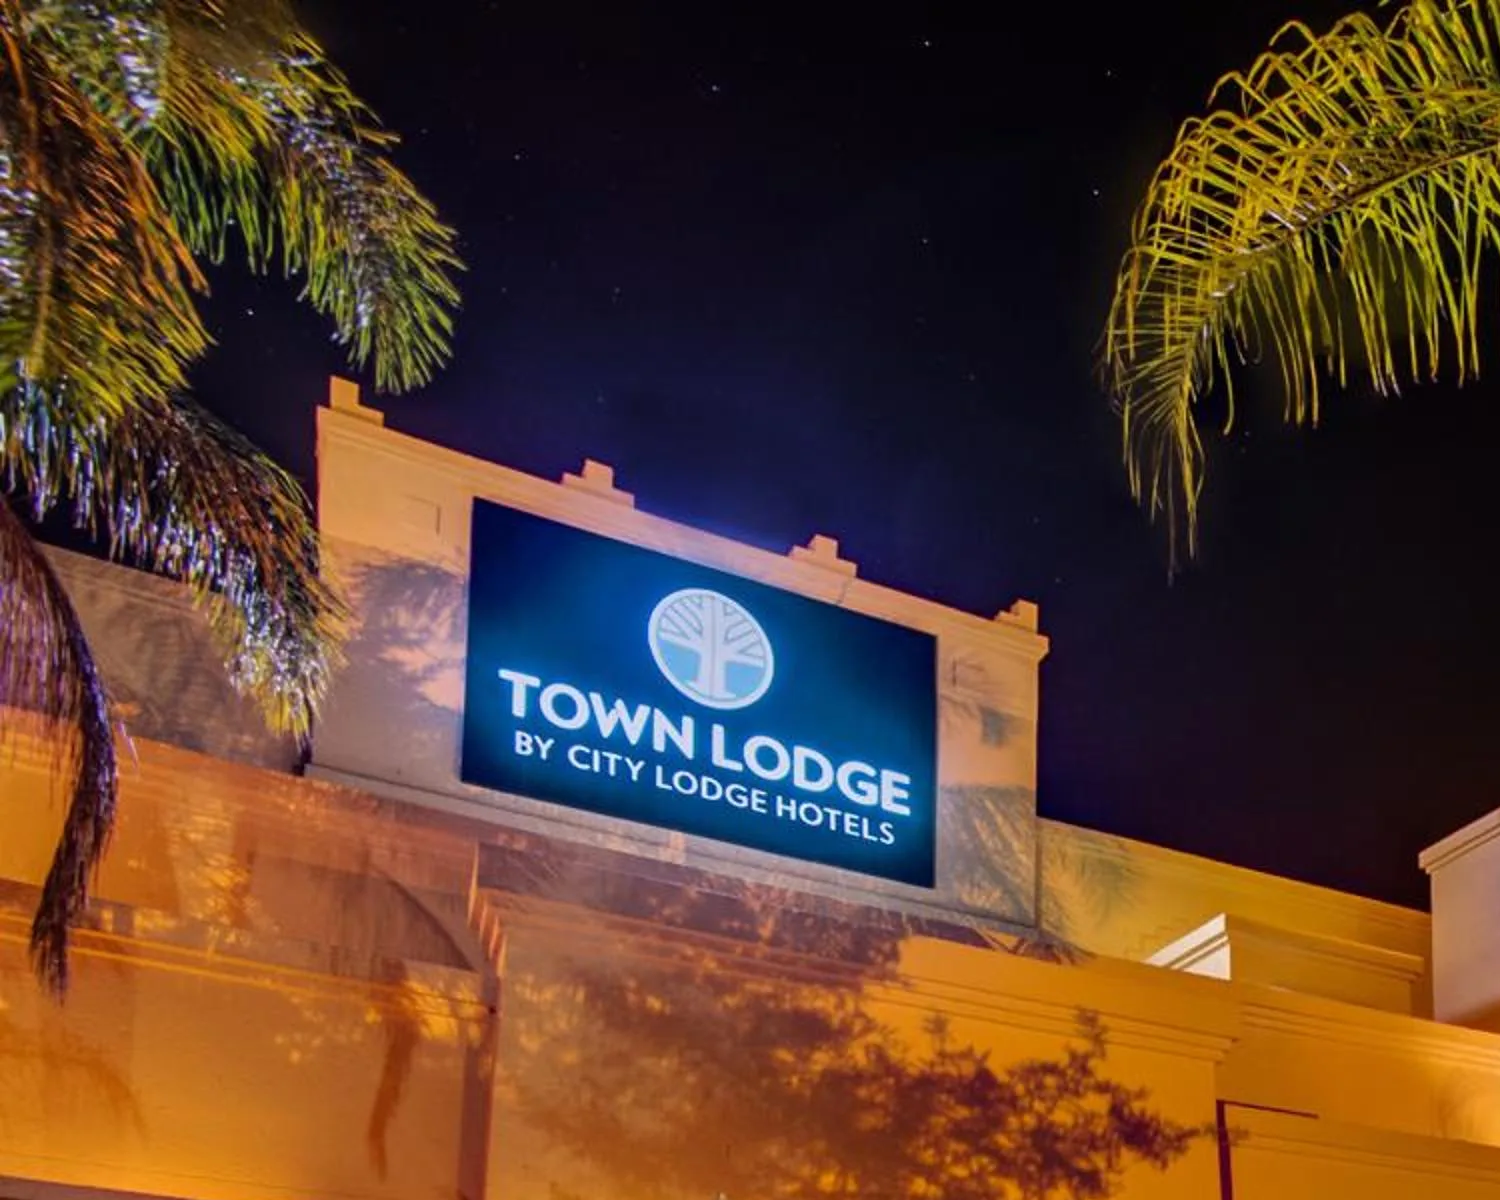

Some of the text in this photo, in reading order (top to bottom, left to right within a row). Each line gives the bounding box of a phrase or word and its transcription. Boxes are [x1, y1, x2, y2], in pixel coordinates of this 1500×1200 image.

[498, 669, 911, 816] TOWN LODGE
[515, 730, 896, 846] BY CITY LODGE HOTELS
